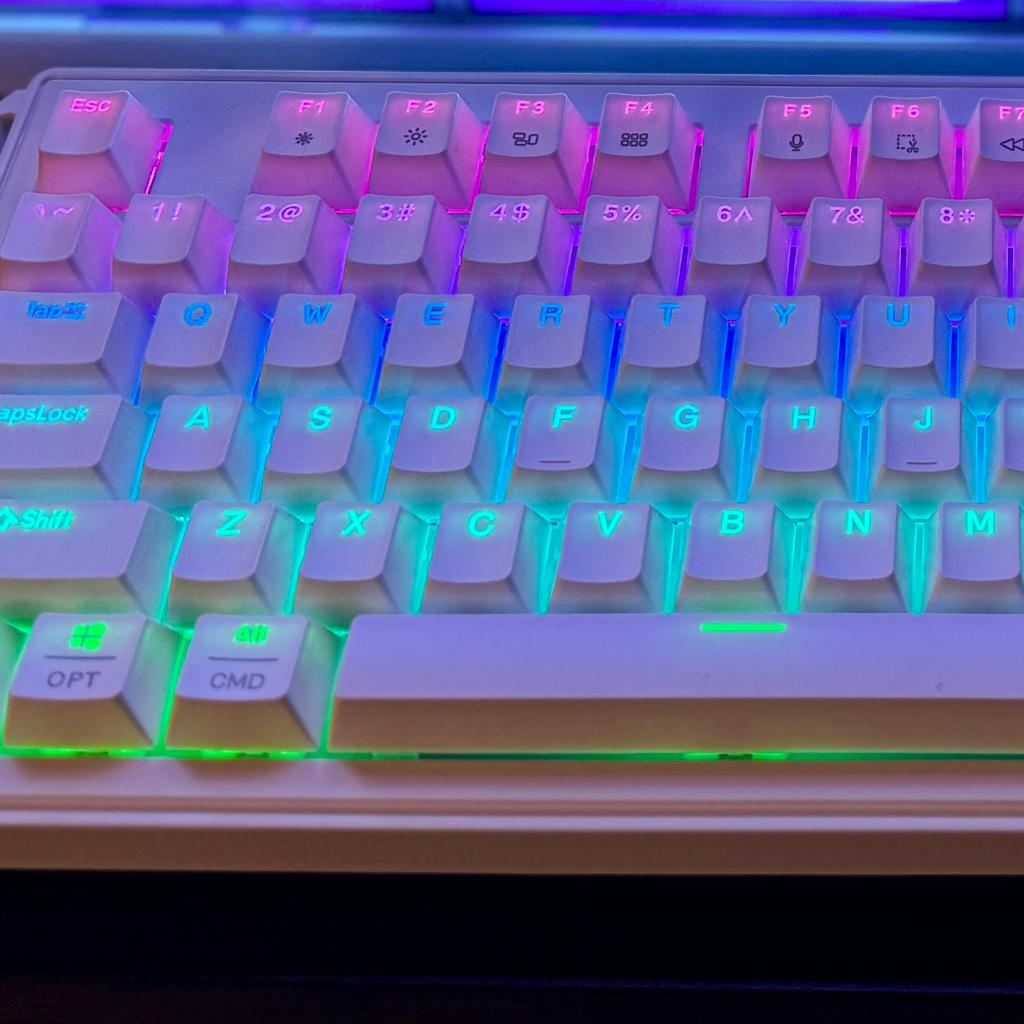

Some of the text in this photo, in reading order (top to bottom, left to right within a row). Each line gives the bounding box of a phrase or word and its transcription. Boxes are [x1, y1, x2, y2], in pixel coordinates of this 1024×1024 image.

[70, 98, 112, 114] ESC
[298, 99, 326, 114] F1
[406, 99, 437, 115] F2
[515, 100, 546, 115] F3
[624, 100, 654, 115] F4
[783, 104, 813, 119] F5
[891, 104, 920, 119] F6
[303, 302, 332, 326] W
[423, 302, 448, 326] E
[538, 303, 563, 326] R
[658, 303, 680, 326] T
[773, 303, 796, 326] Y
[886, 303, 910, 326] U
[184, 404, 210, 429] A
[307, 404, 334, 431] S
[429, 405, 457, 430] D
[552, 404, 577, 429] F
[673, 404, 699, 429] G
[790, 406, 817, 430] H
[914, 406, 933, 431] J
[215, 509, 248, 536] Z
[341, 509, 372, 536] X
[467, 510, 497, 537] C
[597, 511, 623, 537] V
[720, 509, 746, 536] B
[846, 509, 871, 536] N
[965, 509, 995, 536] M
[46, 671, 100, 689] OPT
[210, 673, 265, 690] CMD
